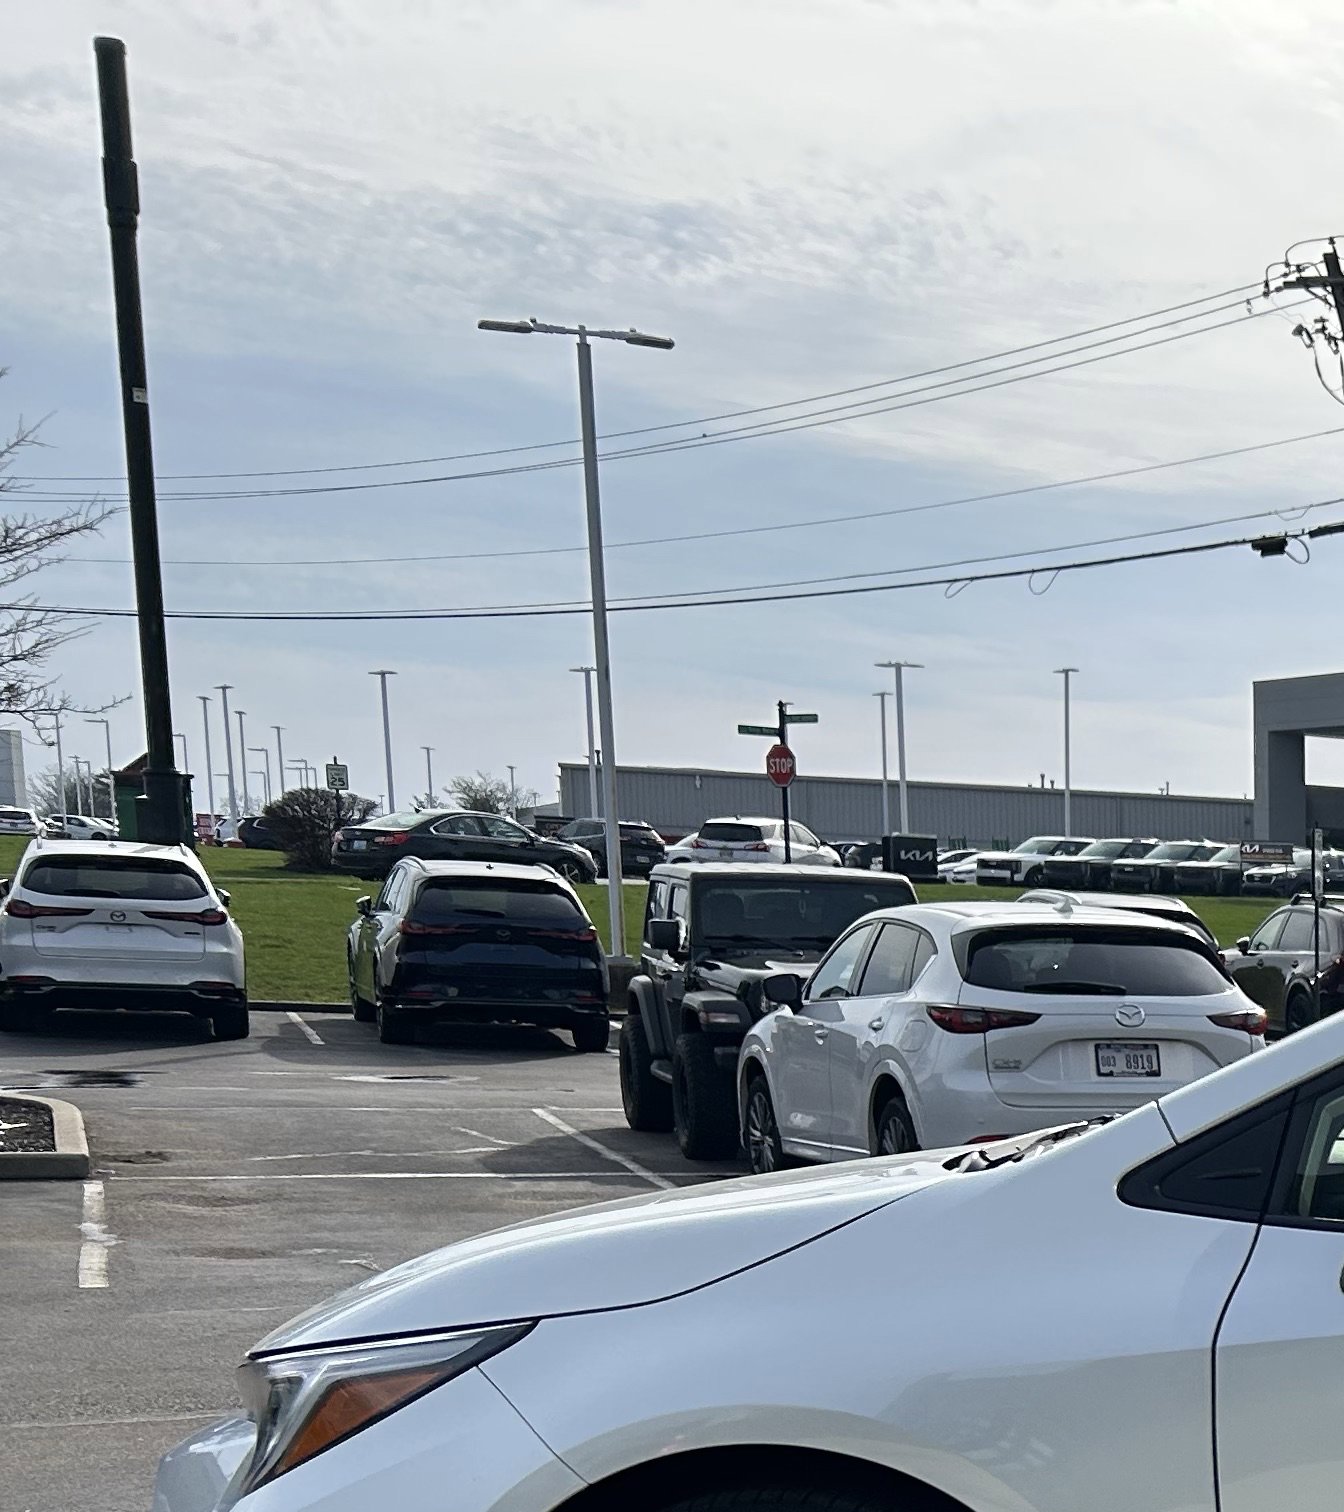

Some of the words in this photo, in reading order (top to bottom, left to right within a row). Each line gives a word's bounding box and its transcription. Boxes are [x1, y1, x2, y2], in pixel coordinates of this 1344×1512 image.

[769, 758, 793, 773] STOP
[330, 776, 345, 786] 25
[900, 850, 933, 861] KIA
[1125, 1053, 1154, 1070] 8919
